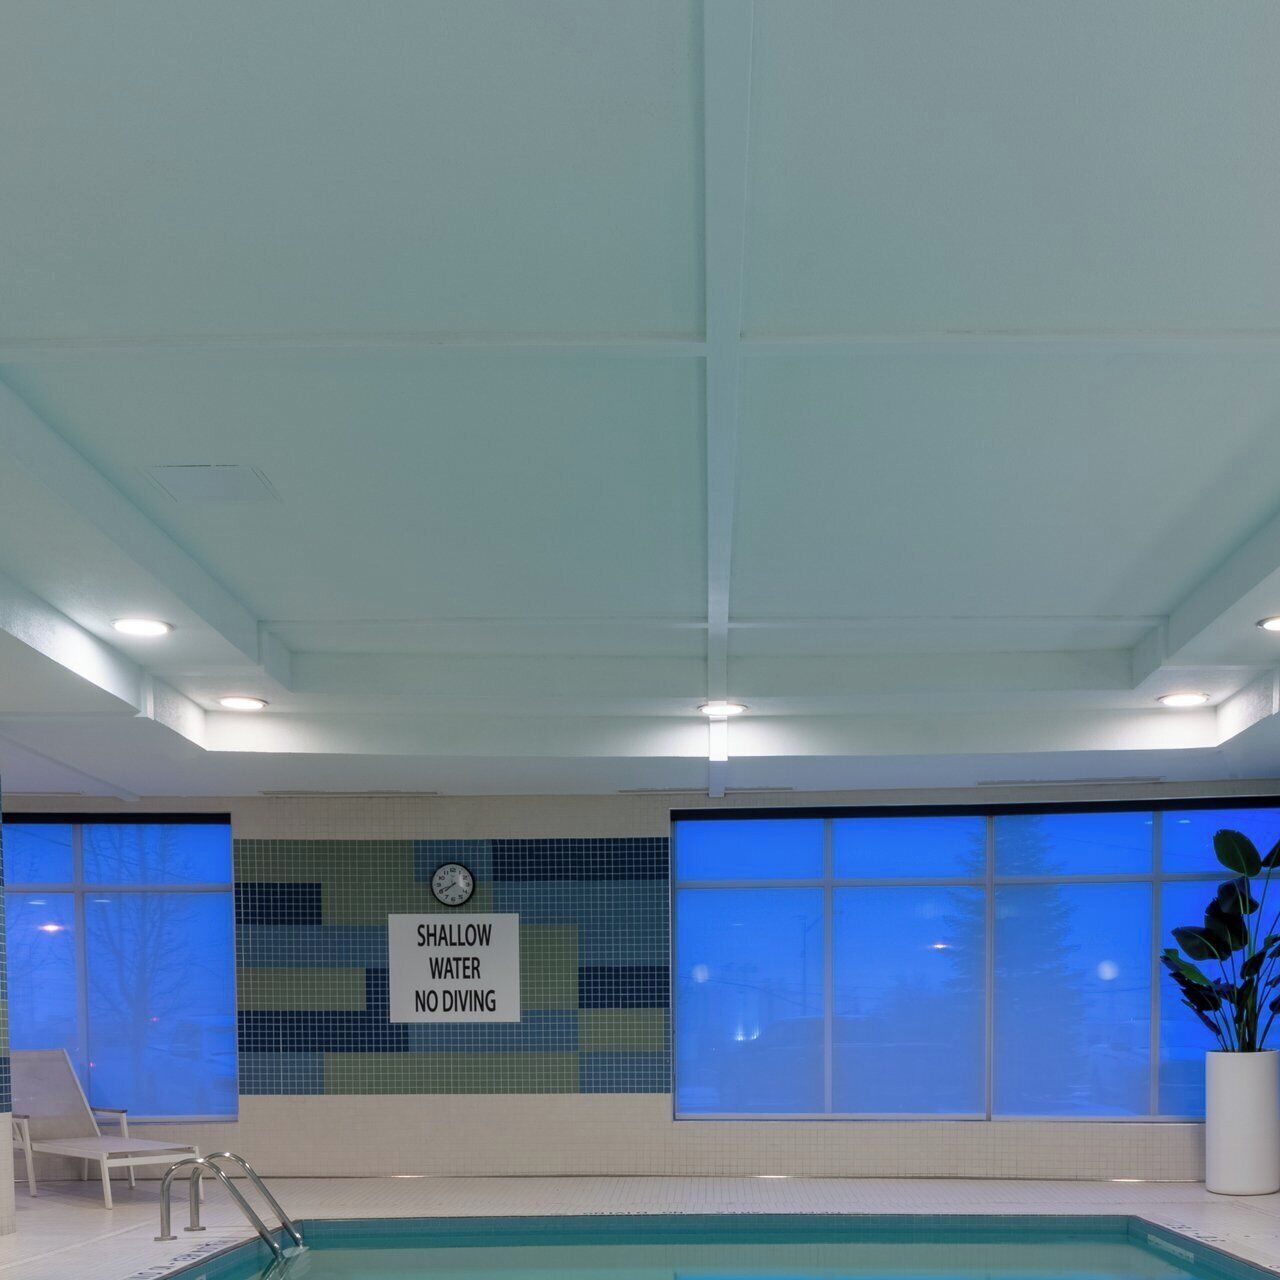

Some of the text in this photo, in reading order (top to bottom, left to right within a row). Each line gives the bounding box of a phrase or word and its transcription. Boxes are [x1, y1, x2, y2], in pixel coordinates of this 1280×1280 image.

[417, 924, 492, 947] SHALLOW
[429, 956, 481, 980] WATER
[415, 989, 496, 1013] NO DIVING
